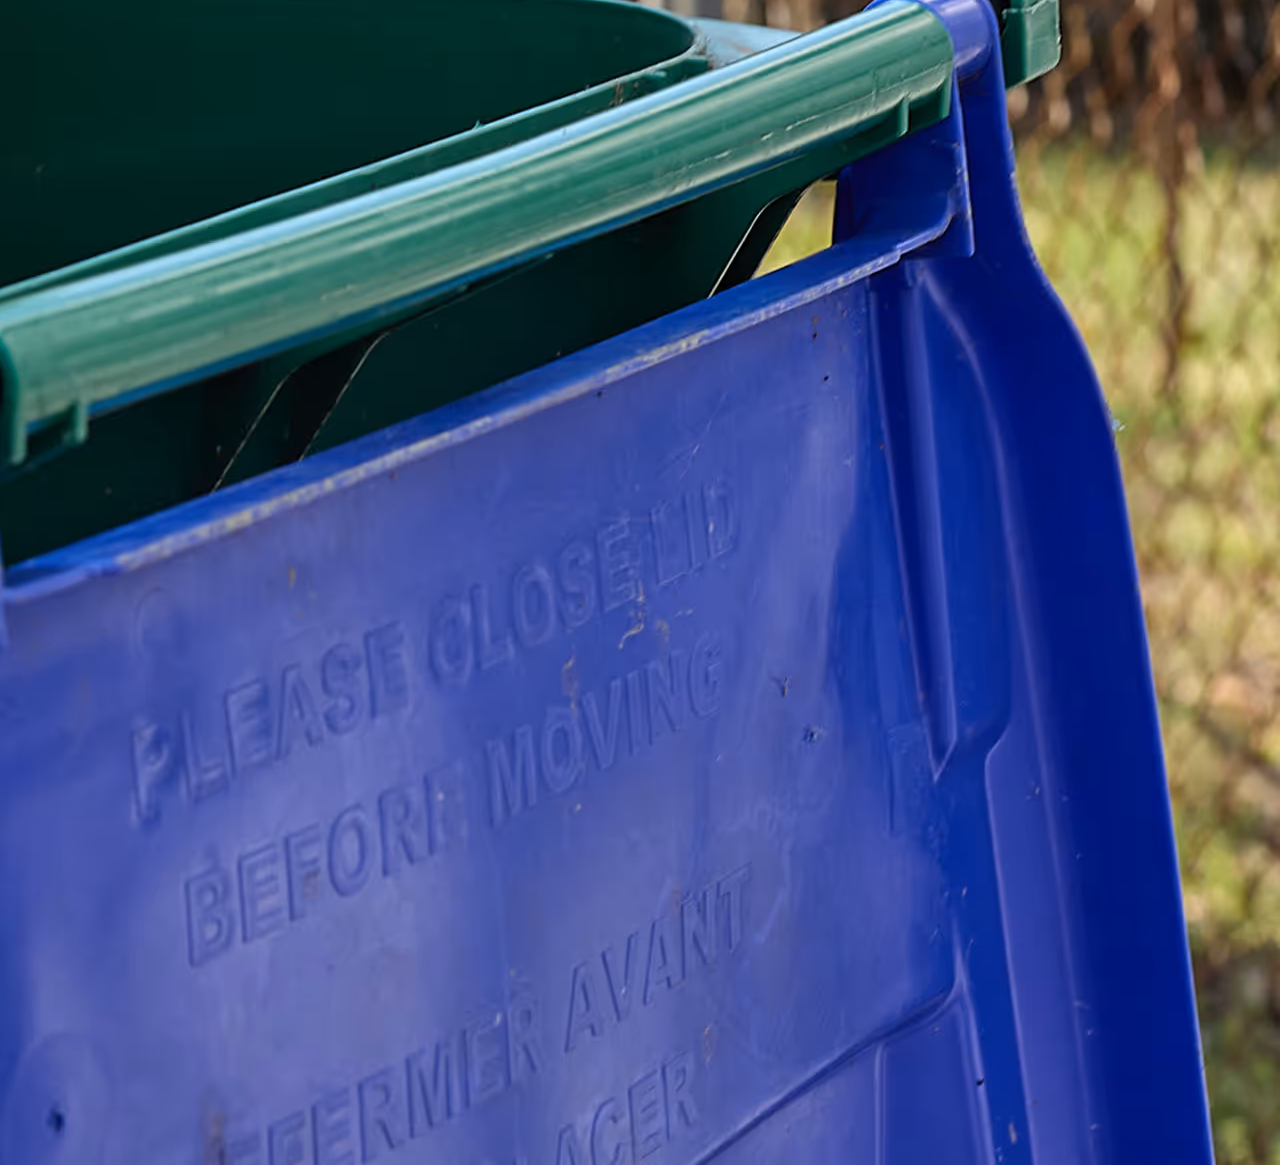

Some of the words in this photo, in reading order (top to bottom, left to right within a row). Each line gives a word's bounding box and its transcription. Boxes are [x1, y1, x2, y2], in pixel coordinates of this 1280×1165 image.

[128, 619, 410, 829] PLEASE
[427, 514, 642, 688] CLOSE
[648, 476, 740, 588] LID
[484, 632, 725, 829] MOVING
[564, 860, 754, 1054] AVANT
